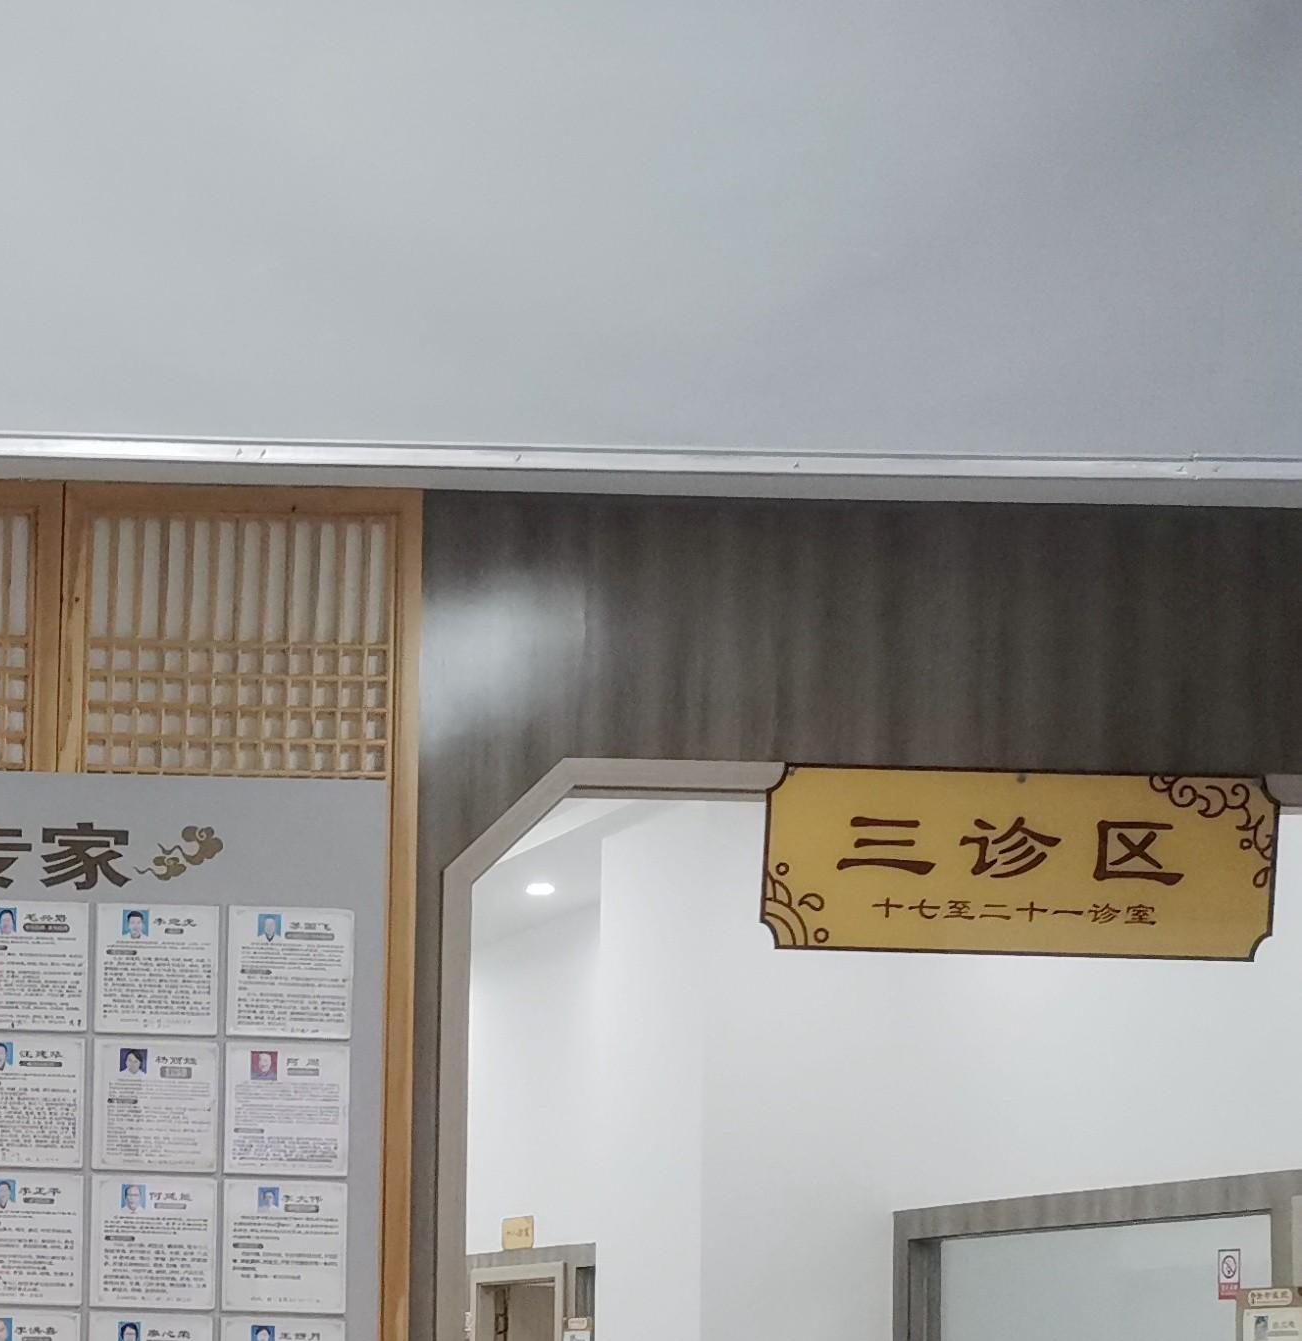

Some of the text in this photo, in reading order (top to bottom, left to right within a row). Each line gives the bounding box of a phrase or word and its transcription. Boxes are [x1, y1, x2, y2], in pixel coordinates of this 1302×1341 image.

[837, 816, 1185, 886] 三诊区
[872, 897, 1157, 926] 十七至二十一诊室
